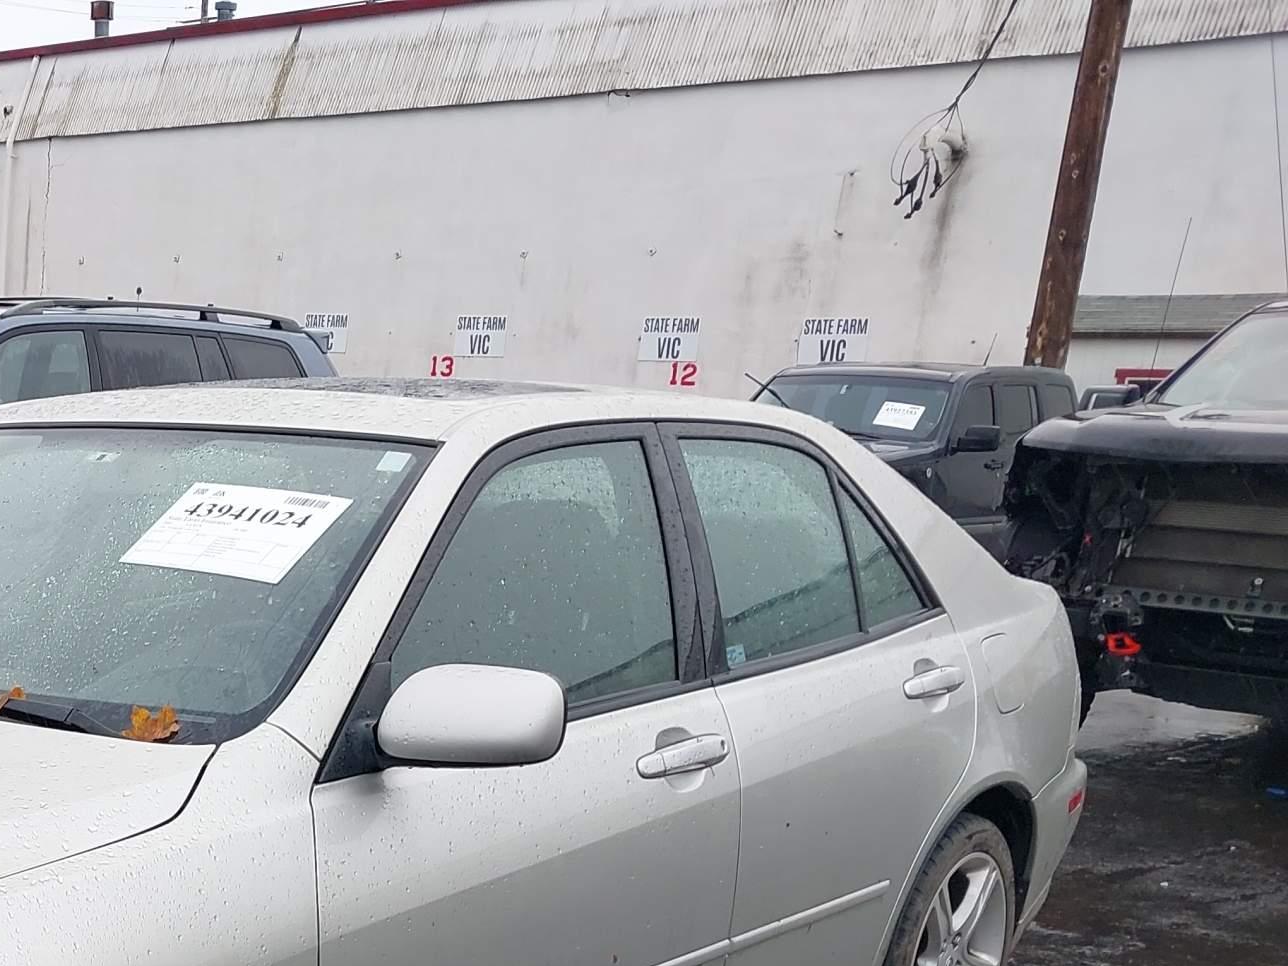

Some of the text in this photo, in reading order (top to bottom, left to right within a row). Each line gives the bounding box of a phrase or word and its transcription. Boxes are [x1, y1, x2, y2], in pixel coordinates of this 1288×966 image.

[305, 314, 349, 329] STATE FARM
[457, 316, 506, 331] STATE FARM
[643, 318, 700, 333] STATE FARM
[803, 318, 868, 335] STATE FARM
[469, 334, 491, 355] VIC
[657, 337, 681, 360] VIC
[819, 339, 847, 362] VIC
[430, 355, 454, 377] 13
[669, 361, 698, 386] 12
[184, 501, 313, 529] 43941024
